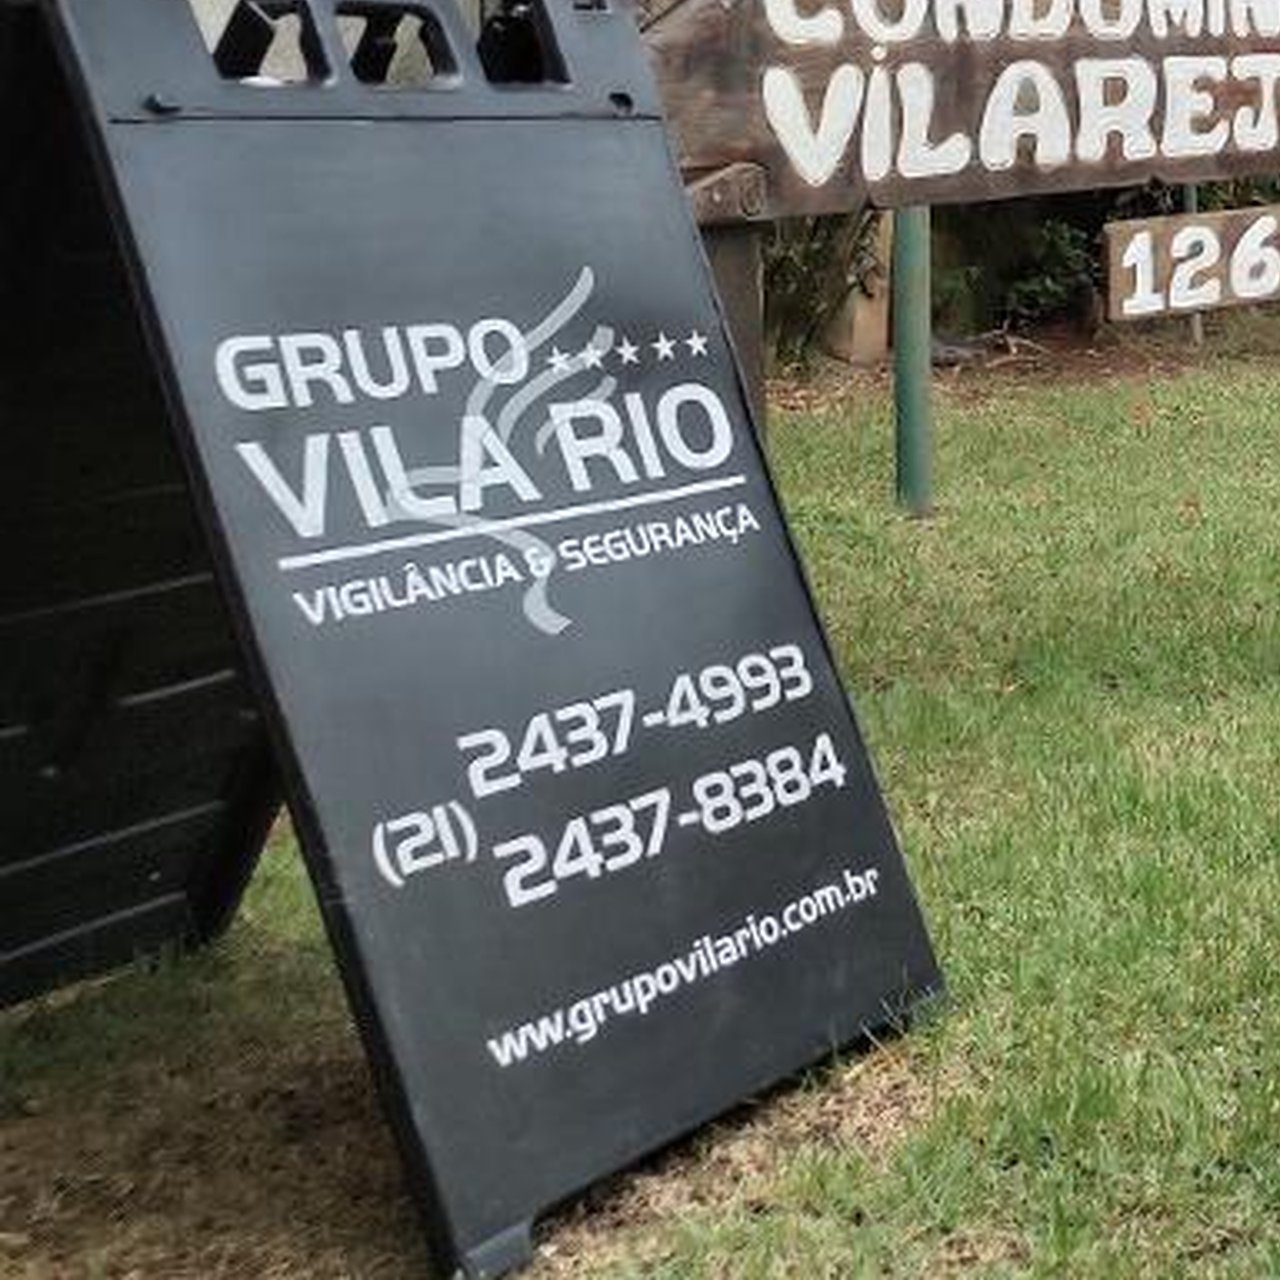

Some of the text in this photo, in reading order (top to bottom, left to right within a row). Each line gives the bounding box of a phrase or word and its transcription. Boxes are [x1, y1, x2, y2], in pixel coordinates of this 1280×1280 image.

[214, 319, 529, 411] GRUPO
[235, 382, 734, 539] VILA RIO
[293, 549, 524, 625] VIGILÂNCIA
[564, 502, 760, 572] SEGURANÇA
[456, 644, 813, 799] 2437-4993
[370, 800, 479, 887] (21)
[492, 732, 847, 908] 2437-8384
[486, 868, 880, 1067] www.grupovilario.com.br
